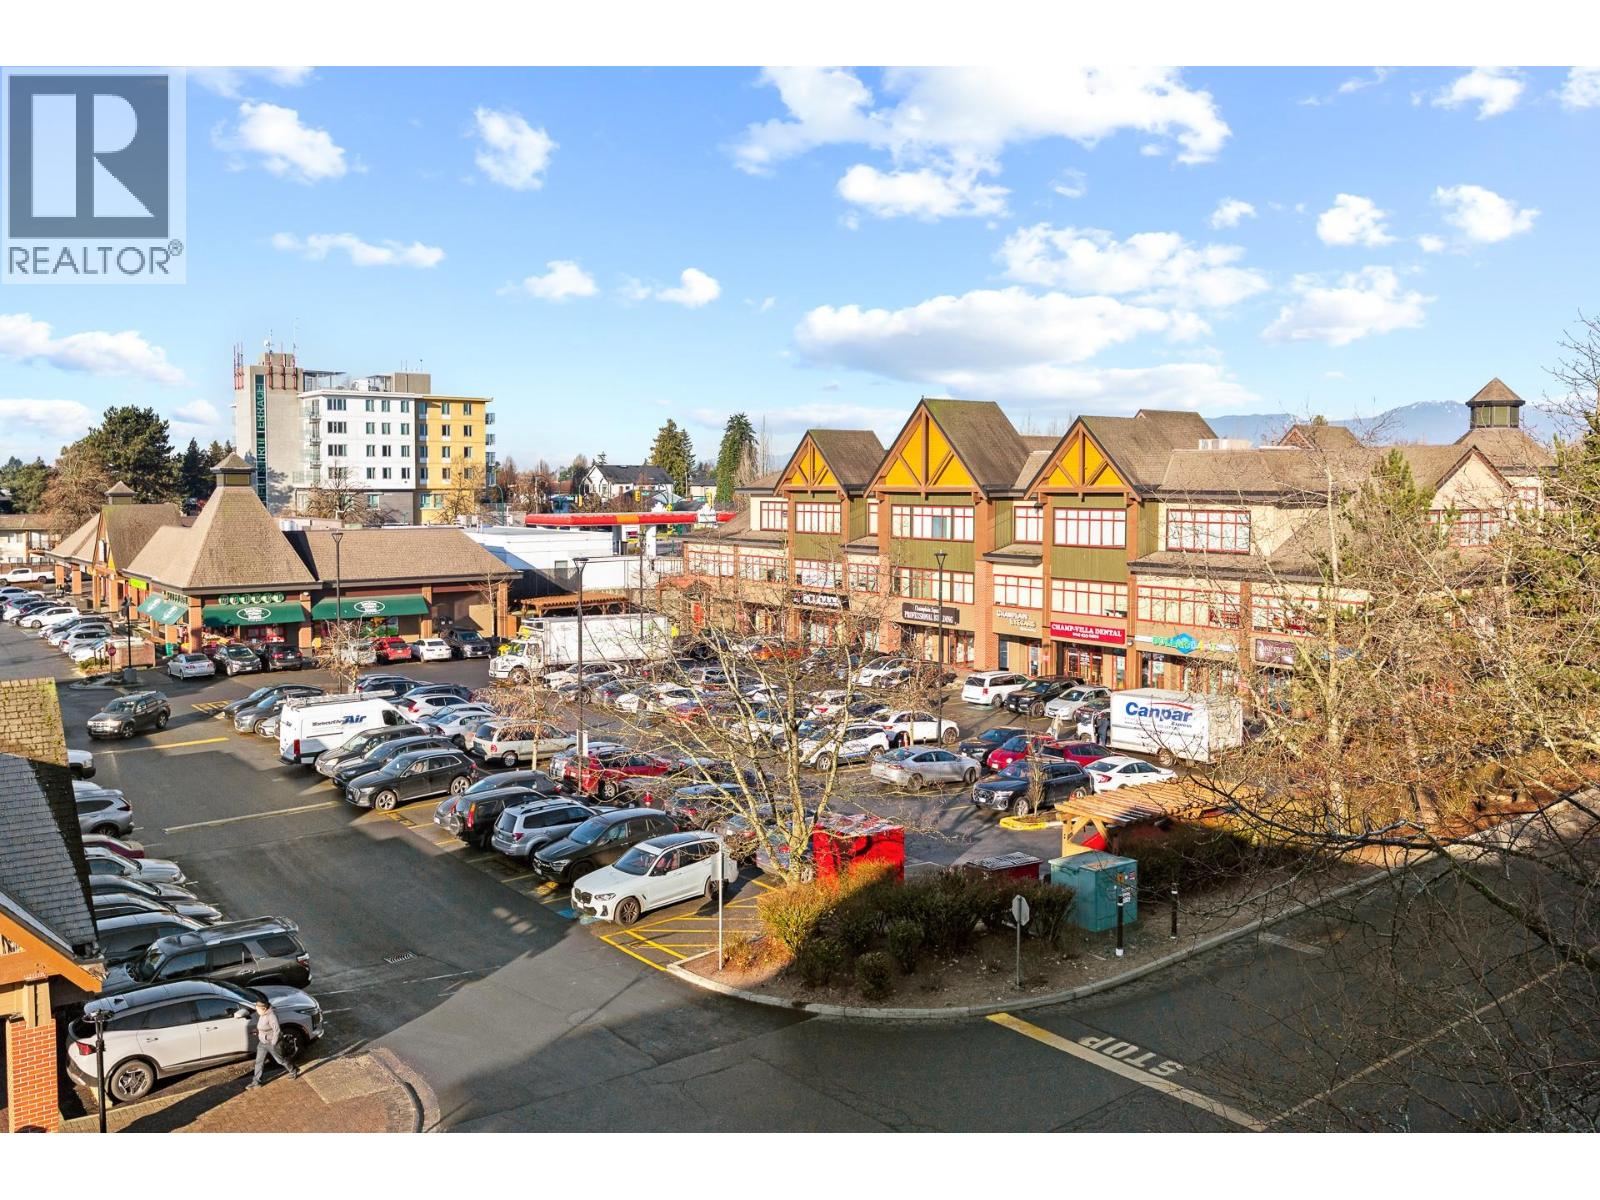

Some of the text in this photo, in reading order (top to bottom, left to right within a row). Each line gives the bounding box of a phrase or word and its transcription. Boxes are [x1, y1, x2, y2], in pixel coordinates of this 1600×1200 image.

[1095, 628, 1122, 638] DENTAL
[342, 714, 367, 725] Air
[1125, 702, 1193, 722] Canpar
[1078, 1037, 1184, 1076] STOP
